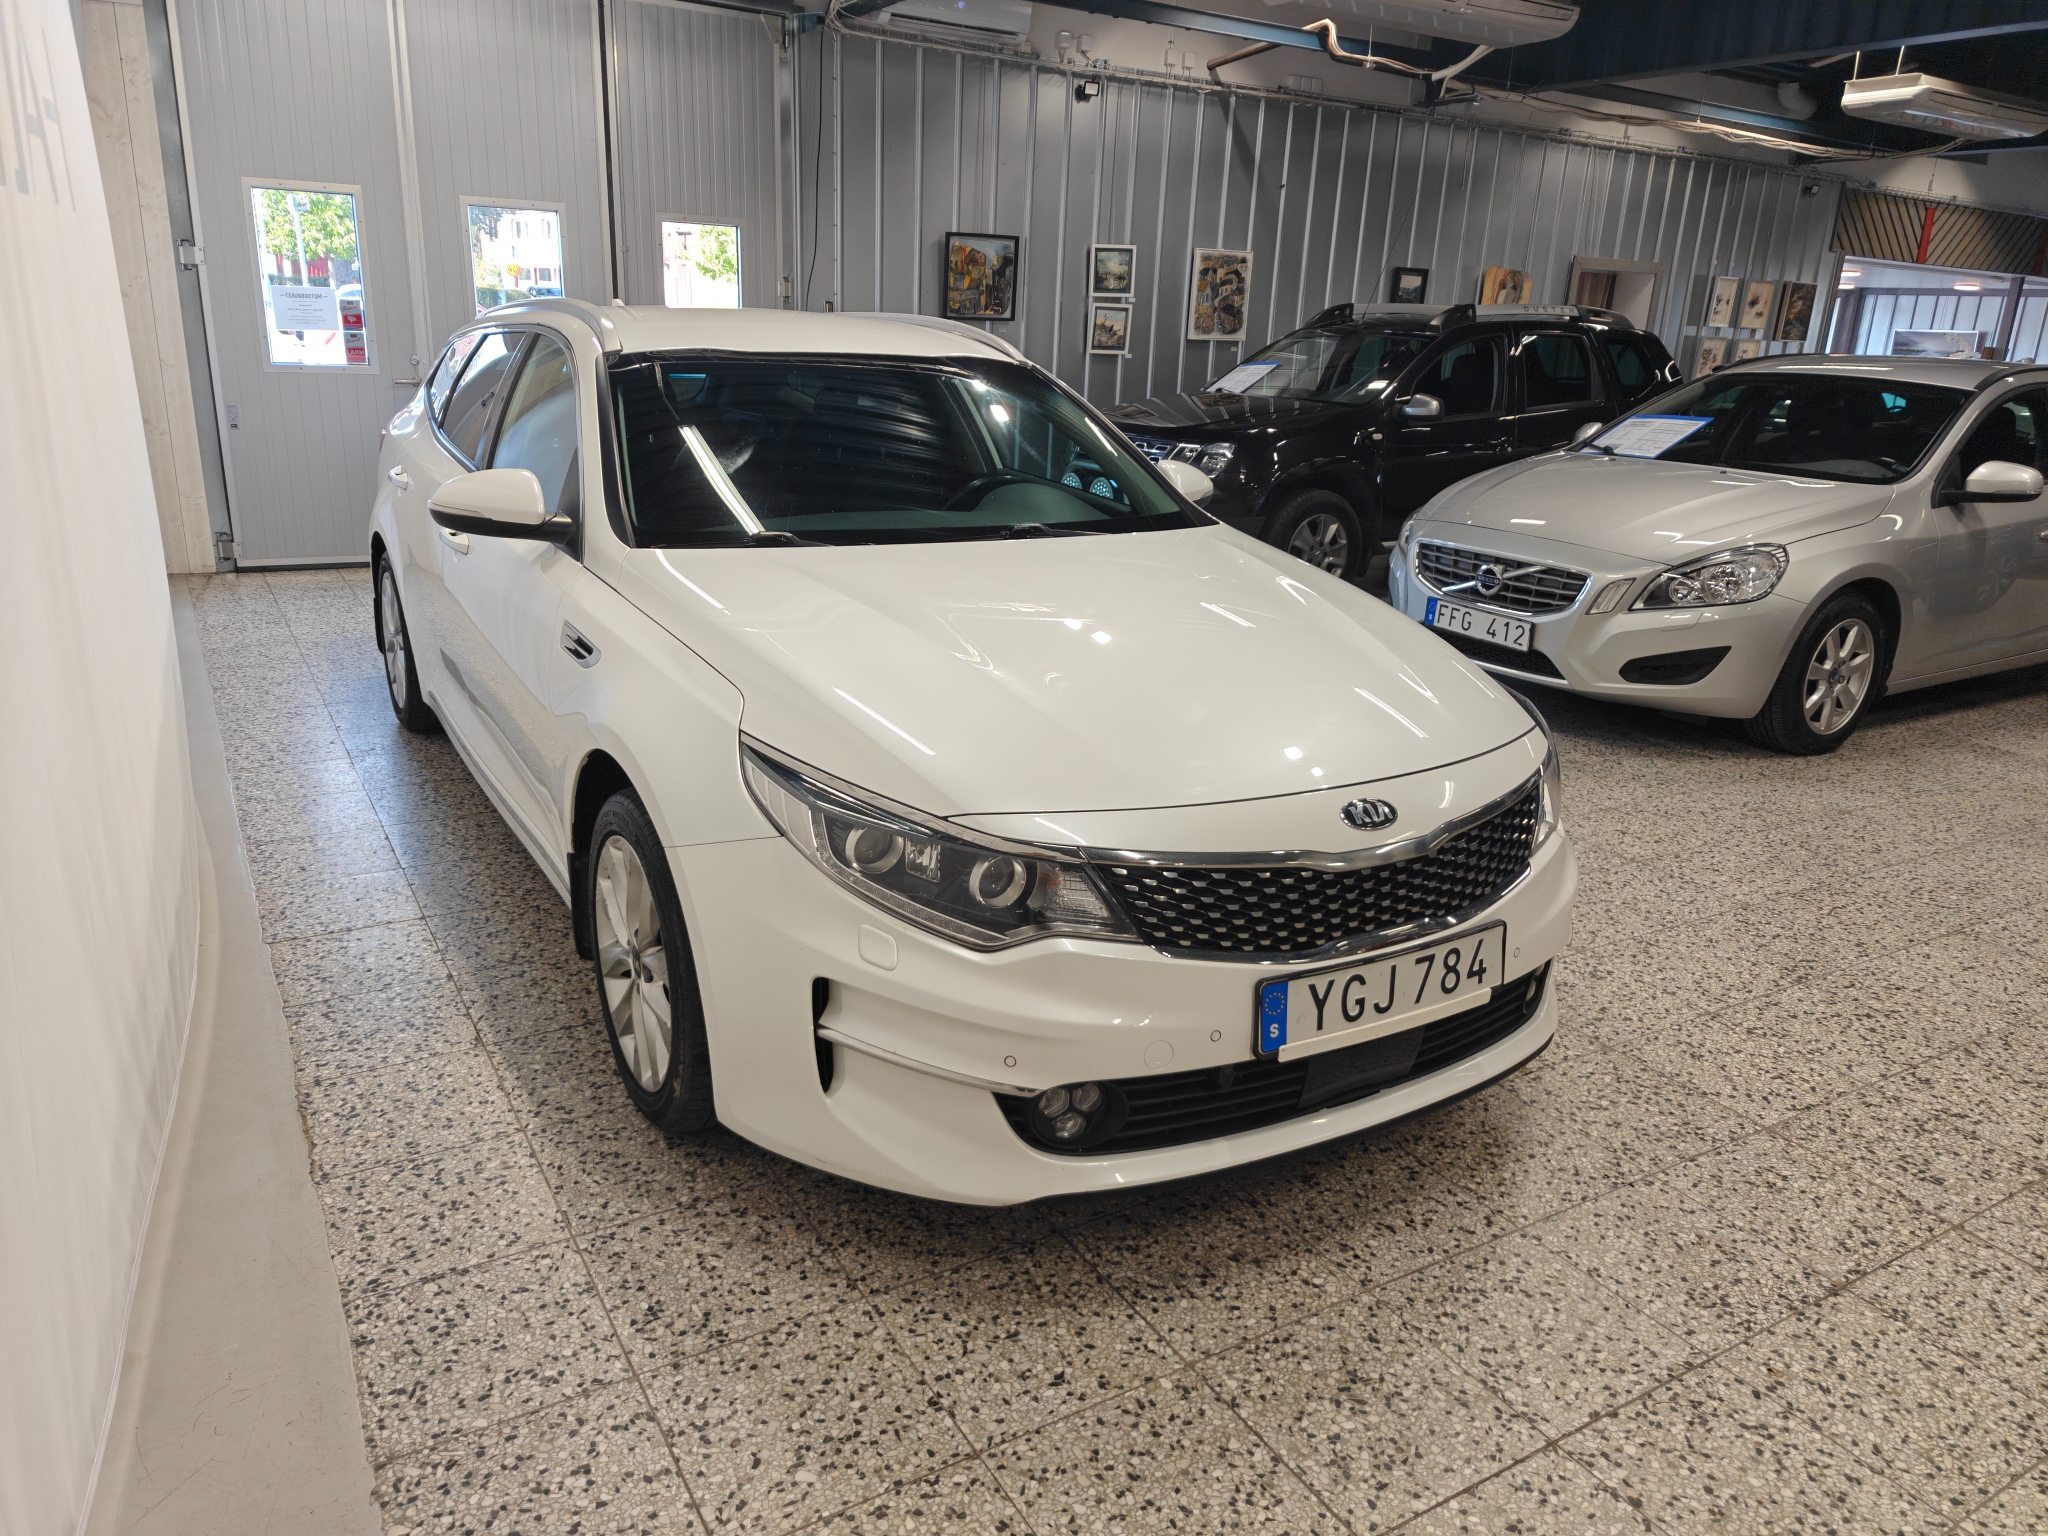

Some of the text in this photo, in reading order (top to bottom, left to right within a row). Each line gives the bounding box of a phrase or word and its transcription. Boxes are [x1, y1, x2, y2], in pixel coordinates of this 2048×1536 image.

[1523, 305, 1575, 314] DUSTER
[1477, 575, 1499, 584] VOLVO
[1437, 603, 1525, 647] FFG 412
[1348, 802, 1394, 825] KIA
[1307, 938, 1487, 1031] YGJ 784
[1269, 1023, 1279, 1038] S
